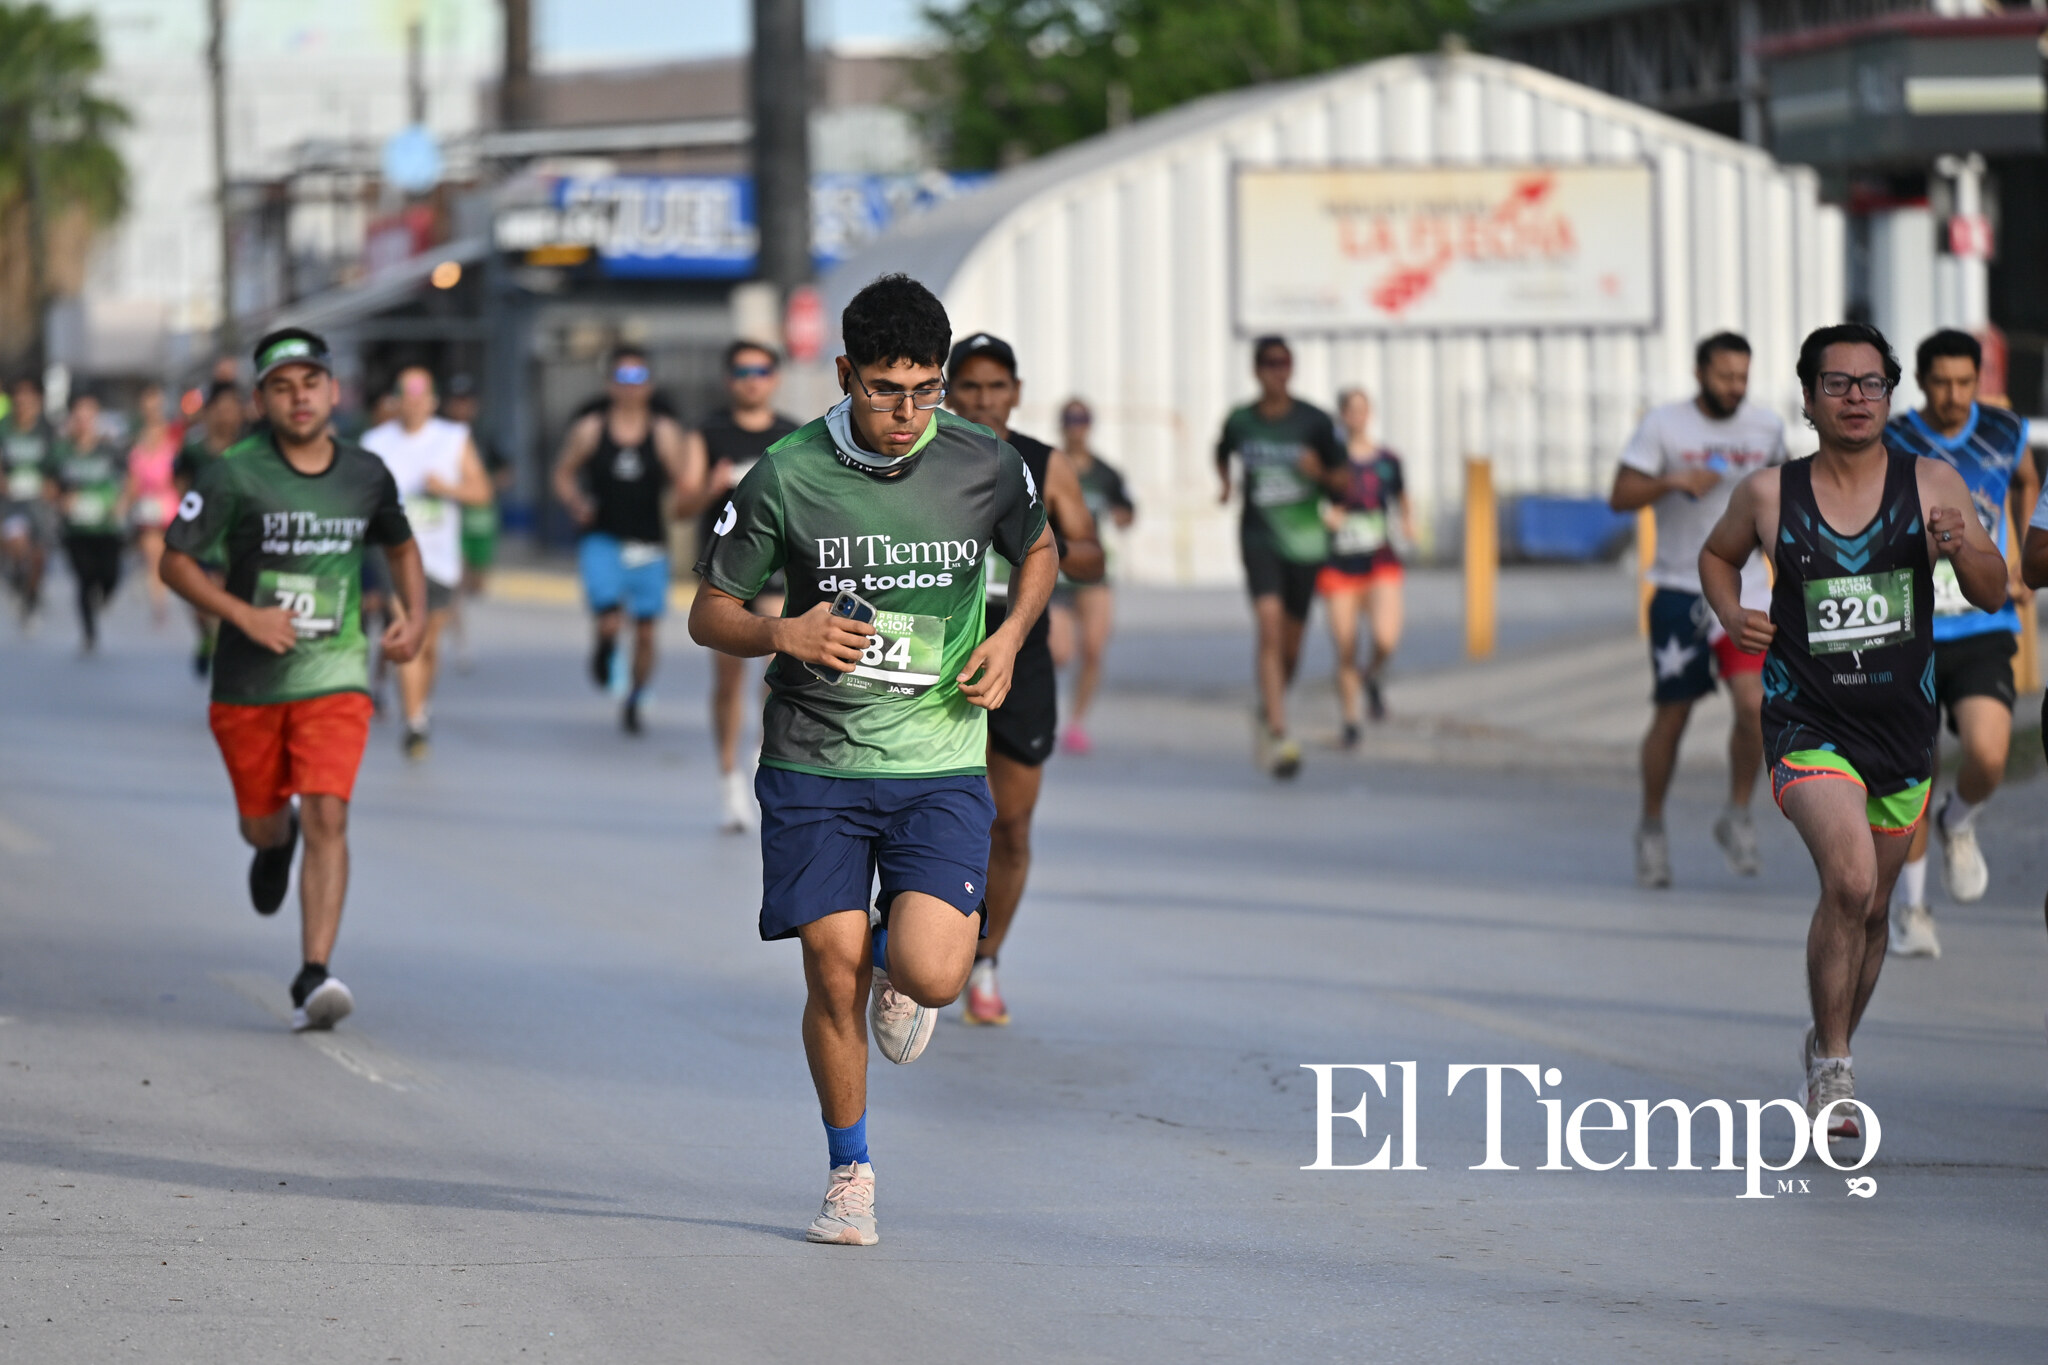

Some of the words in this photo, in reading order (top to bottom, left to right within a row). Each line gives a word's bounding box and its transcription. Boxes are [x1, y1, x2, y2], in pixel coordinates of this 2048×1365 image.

[263, 512, 289, 538] El
[815, 536, 852, 569] El
[856, 535, 978, 570] Tiempo
[818, 575, 857, 592] de
[862, 570, 953, 591] todos
[275, 590, 316, 620] 70
[1818, 593, 1889, 630] 320
[1903, 584, 1911, 632] MEDALLA
[859, 633, 912, 670] 84
